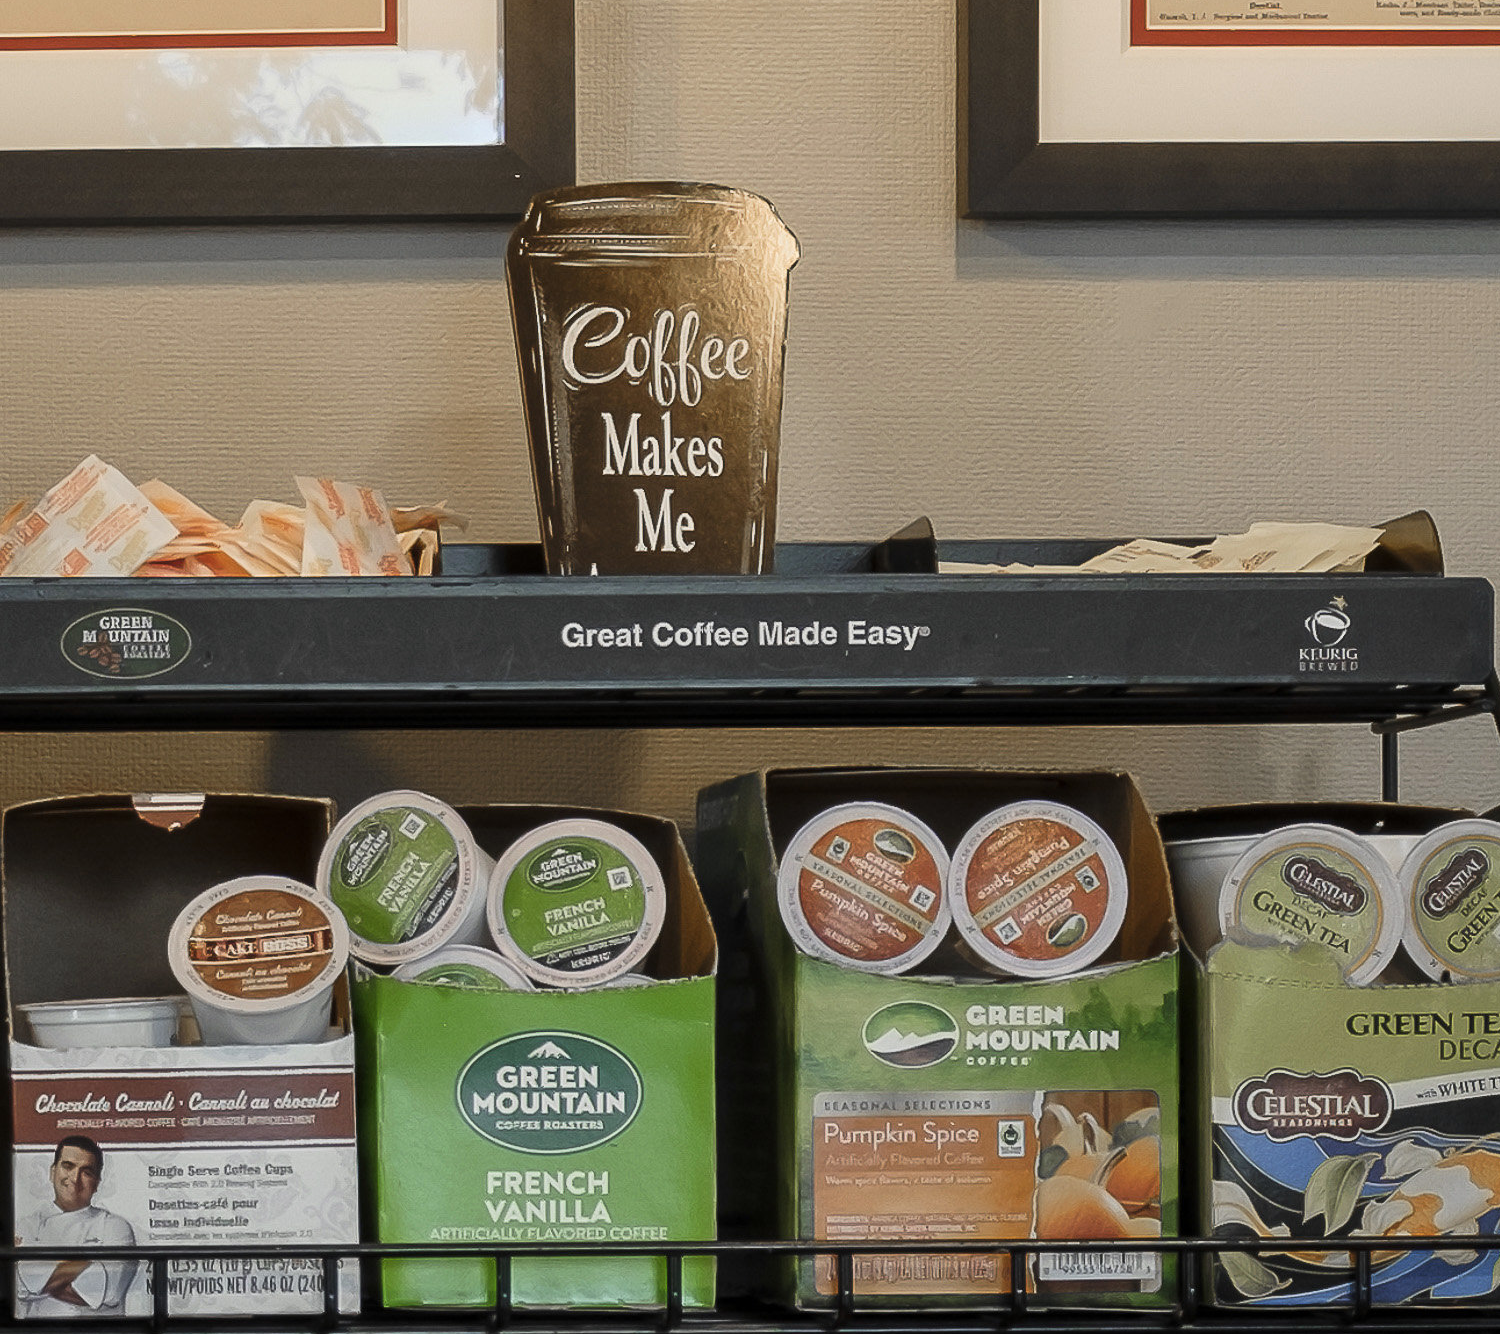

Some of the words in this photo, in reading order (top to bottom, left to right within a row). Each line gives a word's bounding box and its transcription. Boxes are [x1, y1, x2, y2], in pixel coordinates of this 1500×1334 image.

[561, 305, 755, 409] Coffee
[601, 411, 725, 478] Makes
[633, 487, 697, 553] Me
[99, 615, 154, 630] GREEN
[561, 620, 644, 649] Great
[652, 620, 750, 649] Coffee
[758, 619, 839, 648] Made
[1299, 647, 1359, 662] KEURIG
[544, 896, 606, 924] FRENCH
[1252, 890, 1317, 936] GREEN
[1317, 926, 1351, 954] TEA
[546, 911, 611, 937] VANILLA
[1446, 902, 1500, 955] GREEN
[965, 1004, 1065, 1026] GREEN
[1346, 1012, 1453, 1036] GREEN
[965, 1029, 1120, 1052] MOUNTAIN
[496, 1065, 600, 1090] GREEN
[1437, 1078, 1487, 1099] WHITE
[35, 1092, 111, 1114] Chocolate
[115, 1091, 176, 1113] Cannoli
[189, 1089, 248, 1112] Cannoli
[251, 1096, 270, 1110] au
[273, 1088, 341, 1110] chocolat
[472, 1090, 627, 1117] MOUNTAIN
[825, 1101, 897, 1112] SEASONAL
[904, 1099, 992, 1111] SELECTIONS
[1246, 1087, 1380, 1119] CELESTIAL
[495, 1120, 541, 1132] COFFEE
[544, 1119, 605, 1132] ROASTERS
[823, 1122, 918, 1151] Pumpkin
[923, 1122, 981, 1150] Spice
[148, 1165, 184, 1178] Single
[187, 1165, 220, 1176] Serve
[223, 1164, 261, 1176] Coffee
[265, 1163, 294, 1176] Cups
[944, 1153, 986, 1165] Coffee
[486, 1170, 611, 1196] FRENCH
[232, 1199, 259, 1211] pour
[485, 1199, 613, 1224] VANILLA
[429, 1226, 525, 1242] ARTIFICIALLY
[527, 1226, 604, 1241] FLAVORED
[606, 1226, 669, 1241] COFFEE
[226, 1277, 247, 1295] NET
[250, 1276, 277, 1294] 8.46
[279, 1275, 295, 1293] OZ
